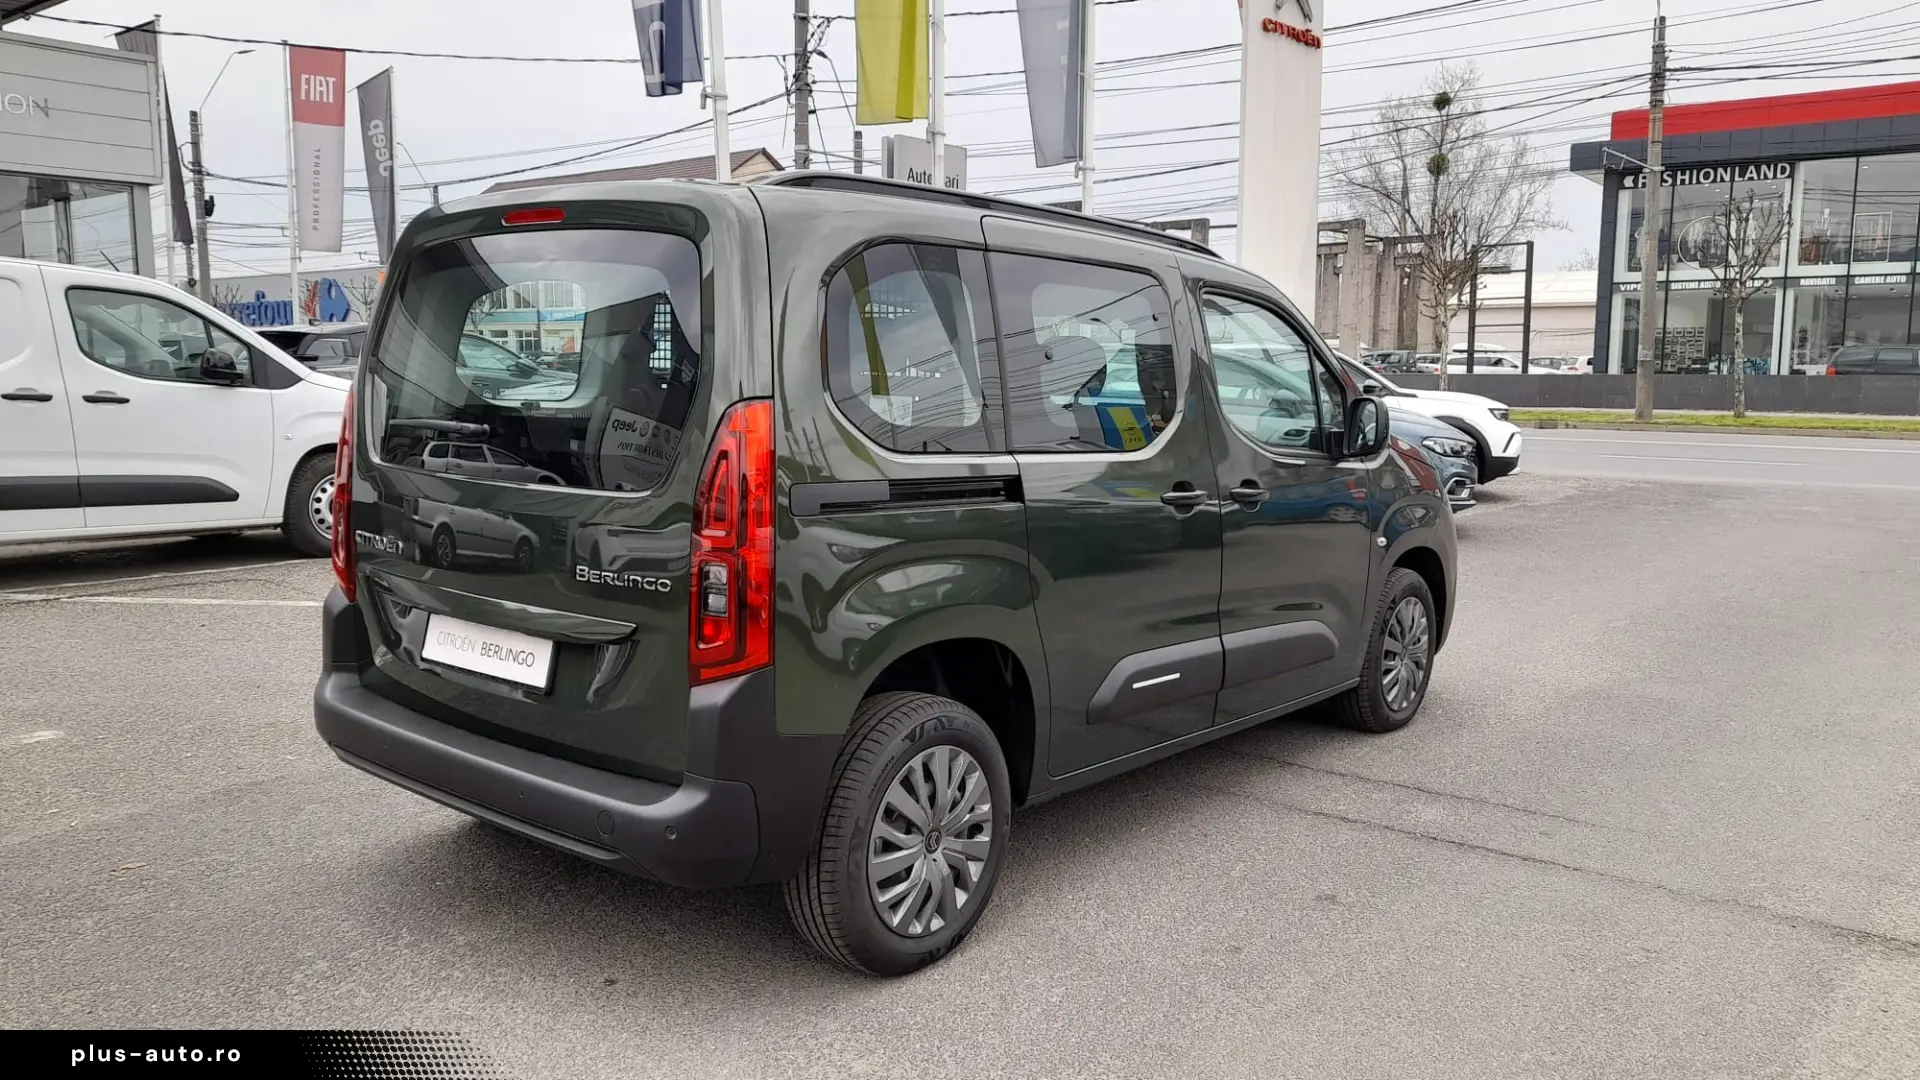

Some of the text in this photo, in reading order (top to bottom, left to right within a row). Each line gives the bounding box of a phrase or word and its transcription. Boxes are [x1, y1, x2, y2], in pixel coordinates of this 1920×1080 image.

[300, 73, 336, 104] FIAT
[1638, 162, 1791, 188] FSHIONLAND
[312, 147, 322, 231] PROFESSIONAL
[1886, 275, 1907, 284] AUTO
[355, 529, 404, 556] CITROËN
[480, 641, 535, 668] BERLINGO
